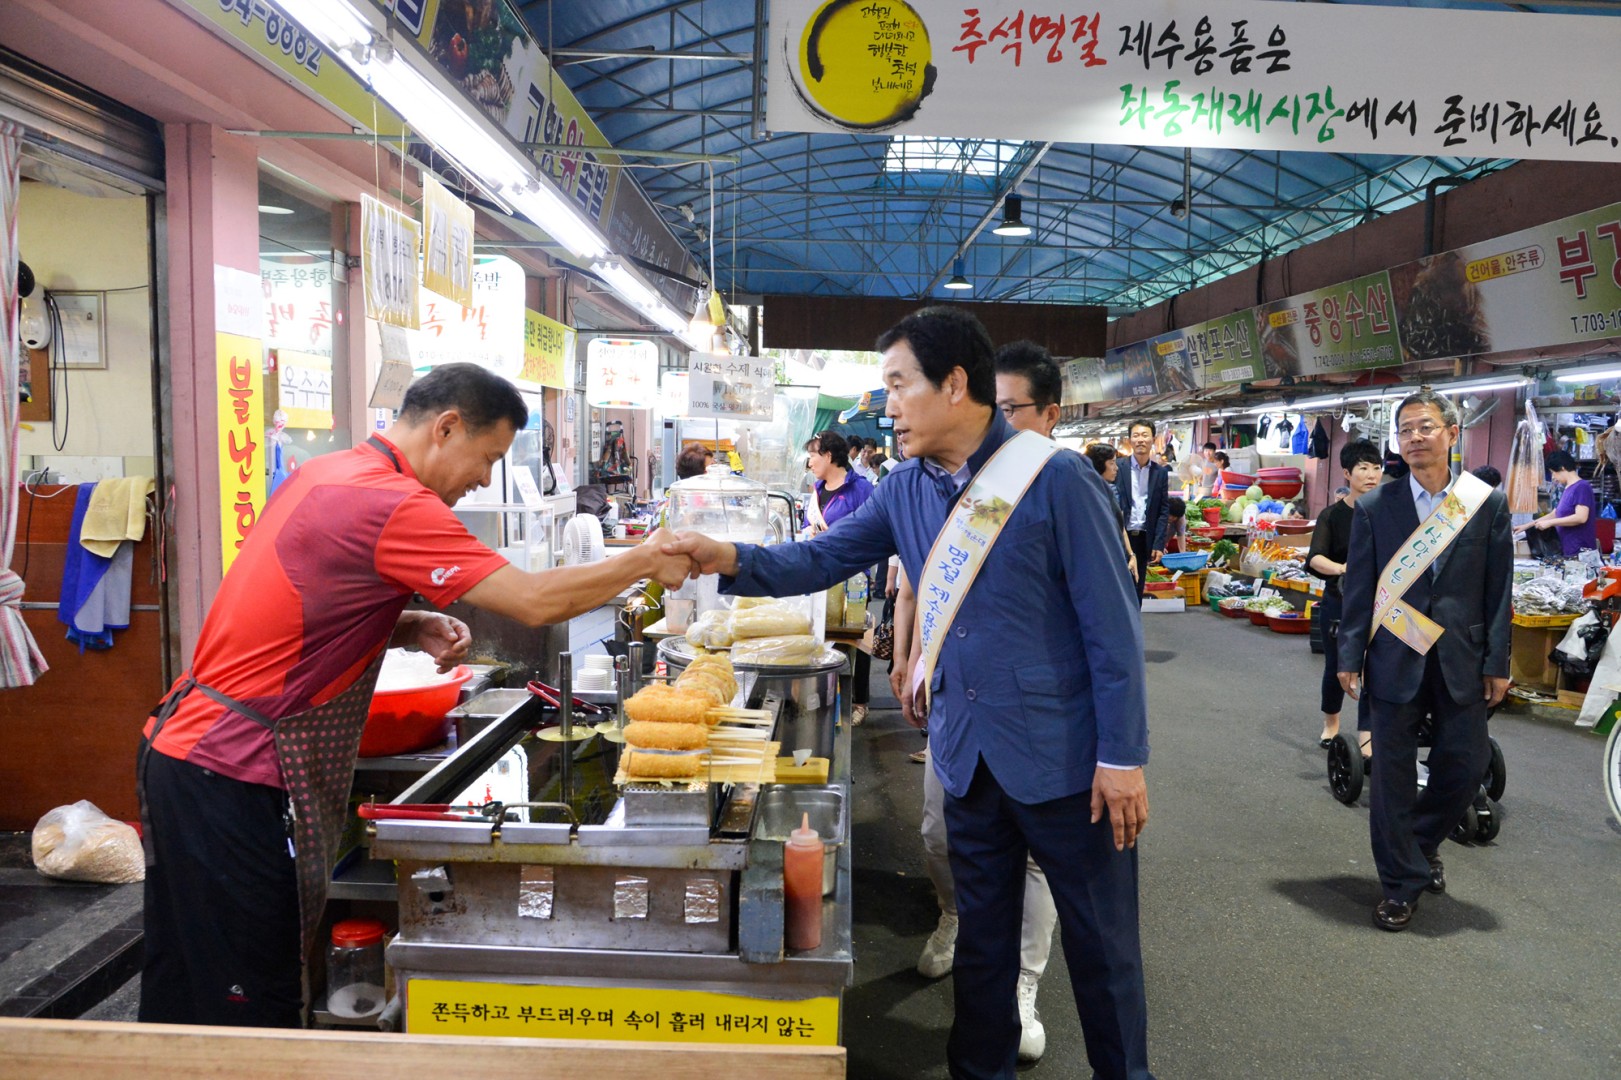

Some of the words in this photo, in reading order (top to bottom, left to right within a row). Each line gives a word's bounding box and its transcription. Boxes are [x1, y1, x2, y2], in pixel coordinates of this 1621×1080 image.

[867, 42, 908, 63] 행복한
[951, 8, 1107, 67] 추석명절
[1118, 15, 1292, 76] 제수용품은
[891, 59, 917, 80] 추석
[1118, 80, 1418, 143] 좌동재래시장에서
[1433, 94, 1620, 149] 준비하세요.
[1470, 249, 1540, 280] 건어물,안주류
[1303, 283, 1391, 347] 중앙수산
[1187, 319, 1253, 368] 삼천포수산
[281, 366, 330, 406] 옥수수
[726, 362, 750, 377] 수제
[692, 401, 709, 409] 100%
[938, 544, 969, 585] 명절
[1391, 526, 1442, 584] 살맛나는
[431, 1002, 510, 1022] 쫀득하고
[517, 1007, 614, 1027] 부드러우며
[624, 1011, 660, 1030] 속이
[669, 1010, 704, 1031] 흘러
[716, 1015, 768, 1033] 내리지
[777, 1018, 815, 1038] 않는
